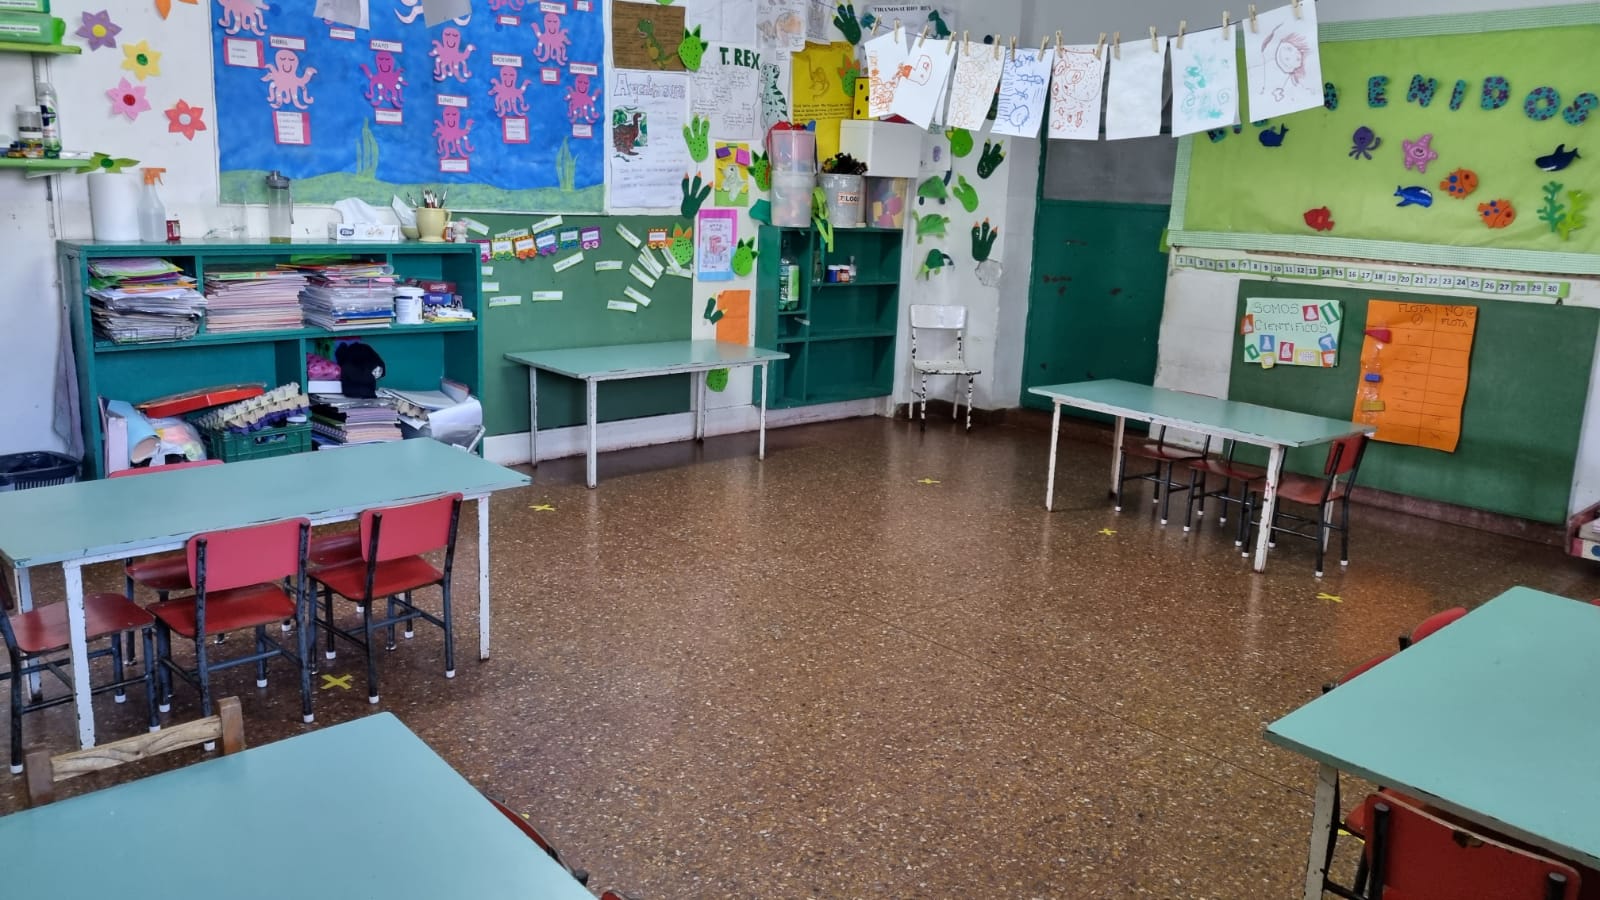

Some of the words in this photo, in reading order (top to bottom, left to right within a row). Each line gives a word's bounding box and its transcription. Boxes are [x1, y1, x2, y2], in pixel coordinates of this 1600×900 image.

[734, 48, 760, 70] REX
[1254, 302, 1299, 315] SOMOS
[1399, 303, 1431, 313] FLOTA
[1445, 306, 1464, 316] NO
[1441, 318, 1468, 328] FLOTA
